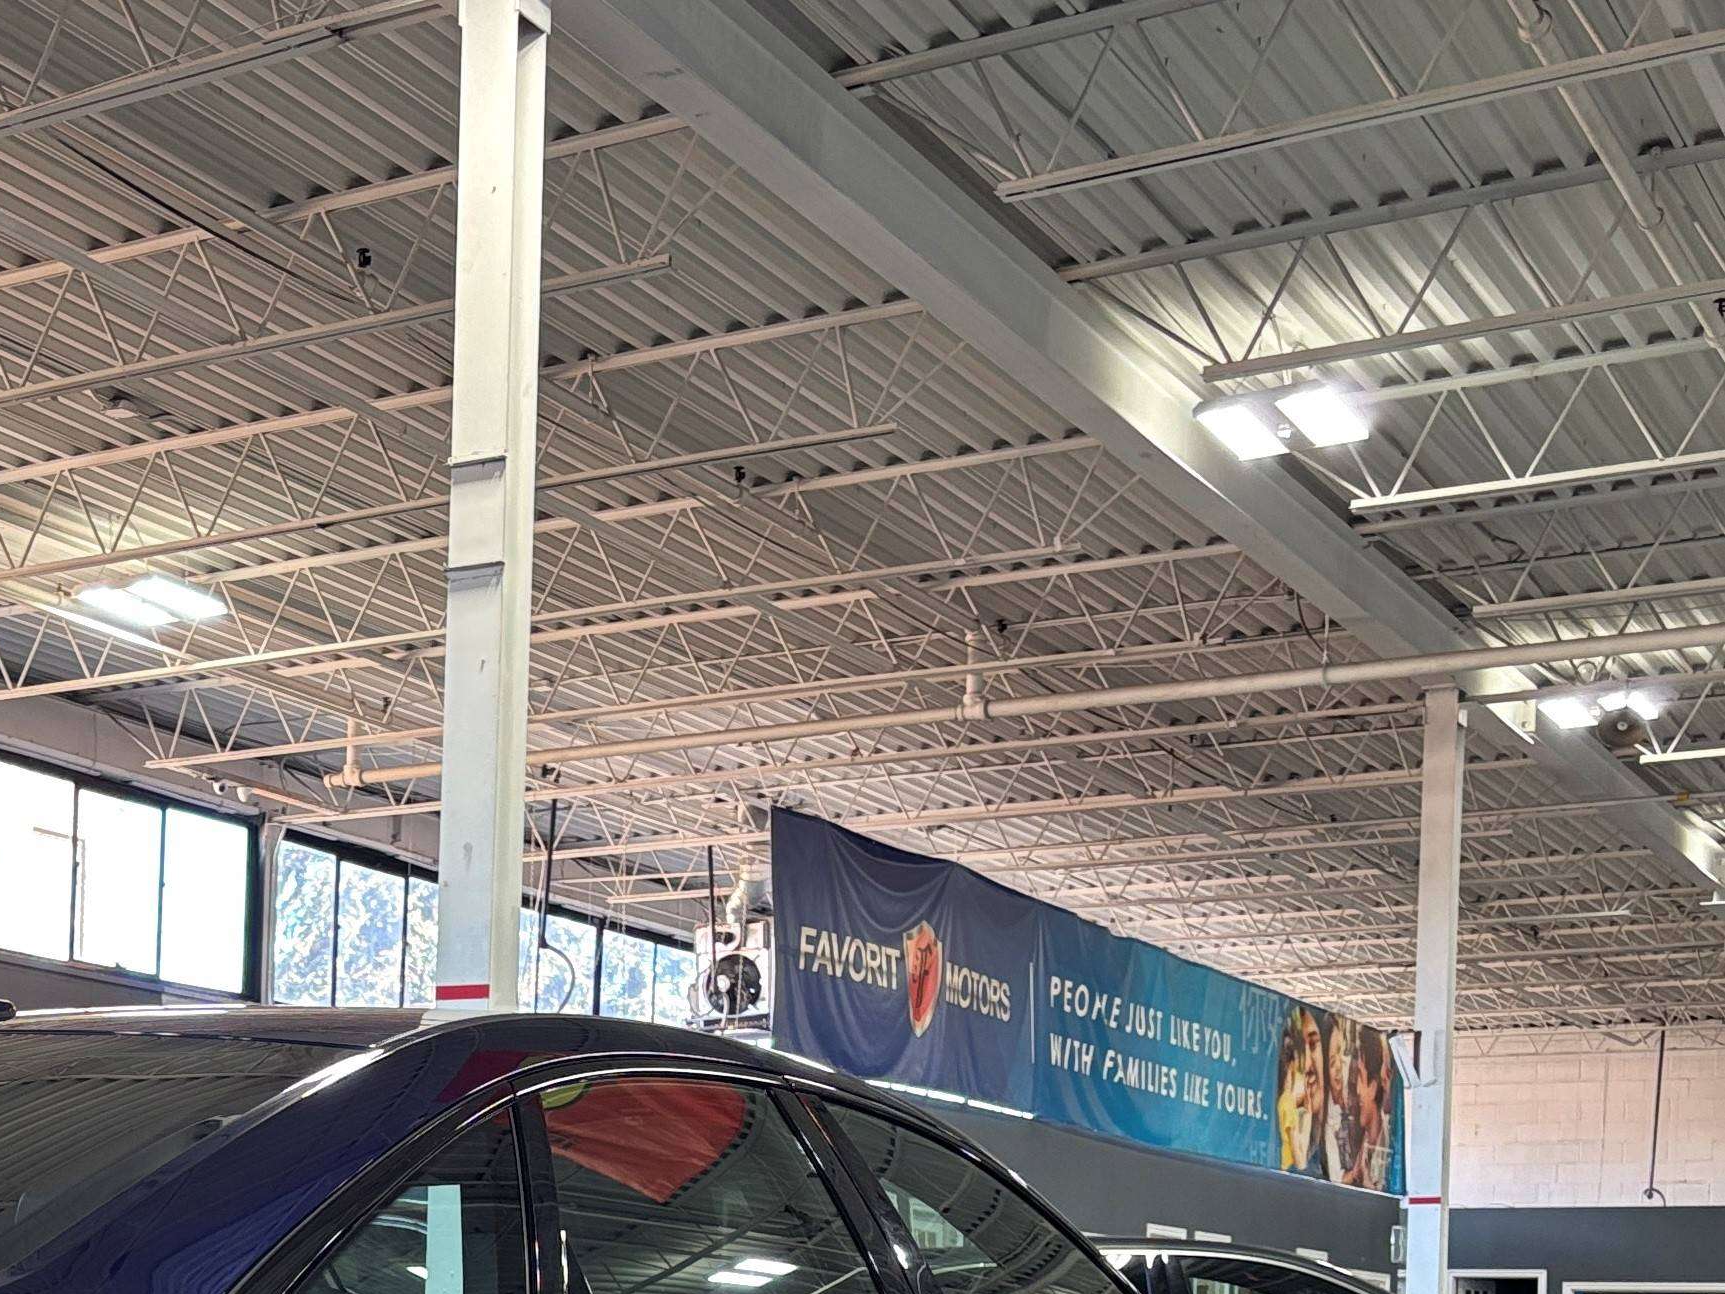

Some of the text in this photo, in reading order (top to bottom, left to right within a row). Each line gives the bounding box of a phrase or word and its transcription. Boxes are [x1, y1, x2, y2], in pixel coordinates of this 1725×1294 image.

[798, 926, 900, 990] FAVORIT
[945, 961, 1011, 1022] MOTORS
[1049, 1032, 1268, 1121] WITH FAMILIES LIKE YOURS.
[1125, 1002, 1163, 1041] JUST
[1169, 1015, 1200, 1052] LIKE
[1204, 1027, 1236, 1067] YOU,
